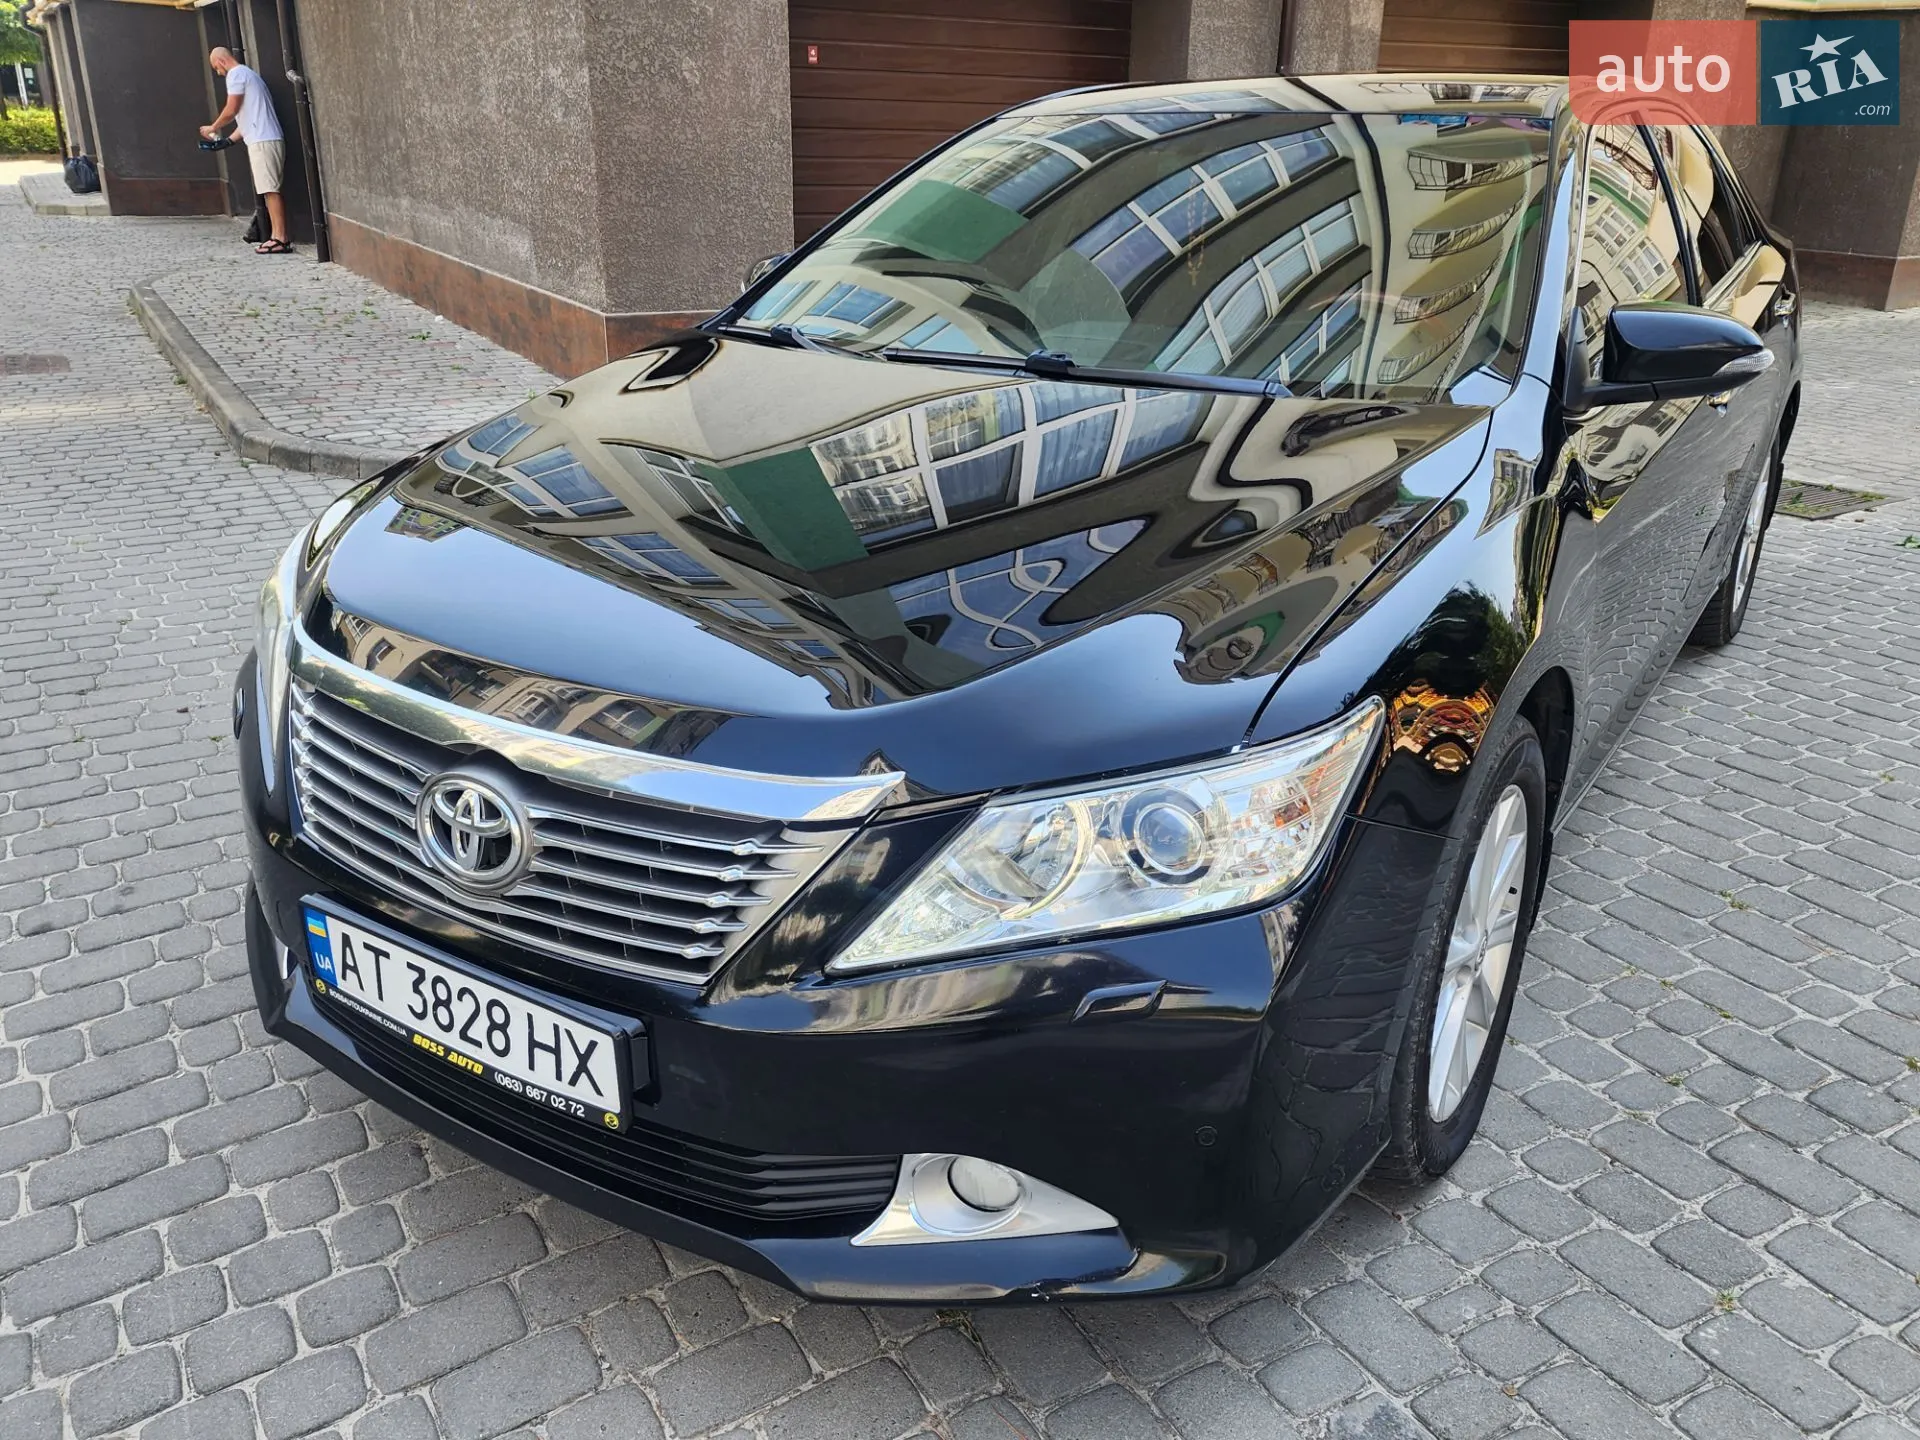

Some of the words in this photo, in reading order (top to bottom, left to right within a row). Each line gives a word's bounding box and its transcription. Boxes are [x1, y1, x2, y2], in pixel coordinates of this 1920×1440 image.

[315, 952, 334, 974] UA
[341, 931, 391, 1002] AT
[406, 960, 511, 1058] 3828
[527, 1012, 604, 1097] HX
[413, 1033, 445, 1057] BOSS
[447, 1051, 484, 1075] AUTO
[494, 1071, 523, 1093] (063)
[525, 1085, 547, 1103] 667
[550, 1095, 567, 1111] 02
[568, 1100, 585, 1118] 72
